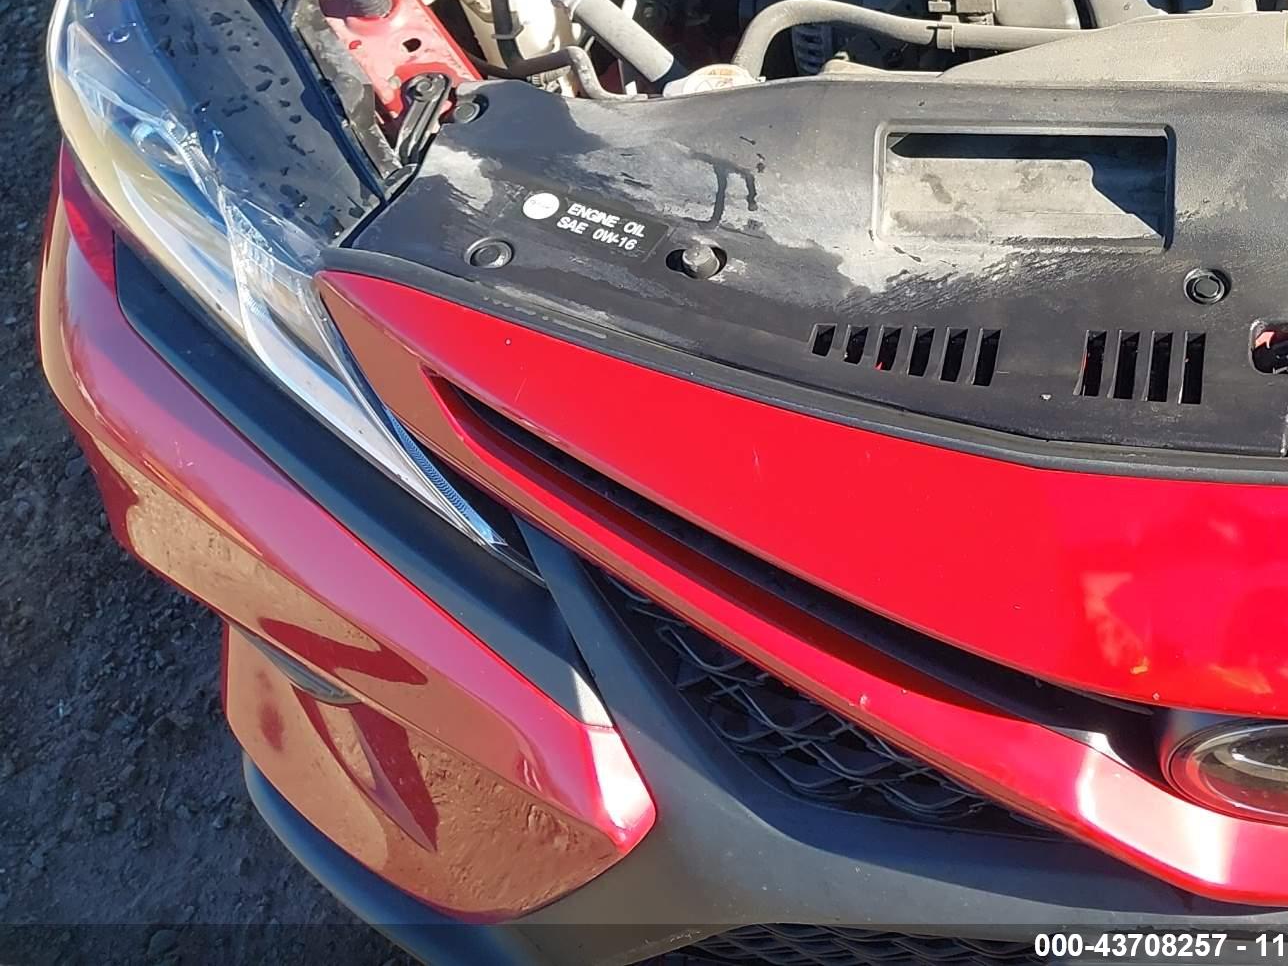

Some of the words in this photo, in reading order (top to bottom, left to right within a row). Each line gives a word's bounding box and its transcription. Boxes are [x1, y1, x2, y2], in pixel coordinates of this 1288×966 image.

[556, 216, 589, 235] SAE
[592, 228, 638, 251] 0W-16
[567, 202, 620, 228] ENGINE
[623, 221, 646, 238] OIL
